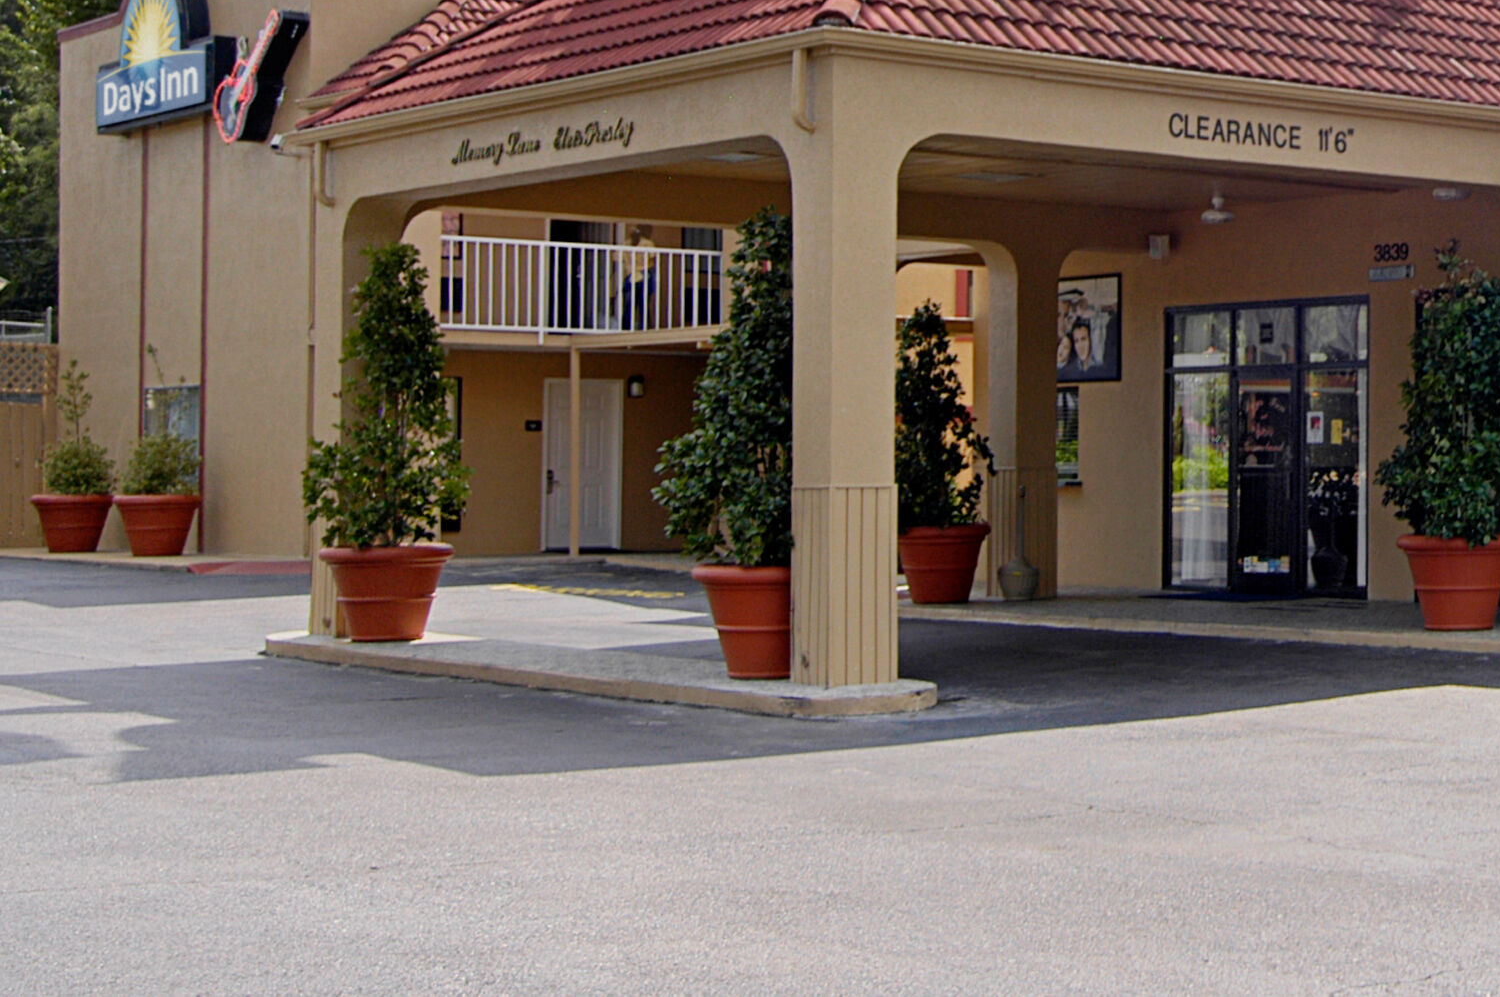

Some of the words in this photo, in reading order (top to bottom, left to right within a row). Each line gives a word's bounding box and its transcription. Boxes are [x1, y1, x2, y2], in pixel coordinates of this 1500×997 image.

[103, 77, 157, 116] Days
[160, 66, 199, 103] Inn
[1168, 112, 1302, 150] CLEARANCE
[451, 138, 505, 166] Memory
[1373, 243, 1410, 262] 3839
